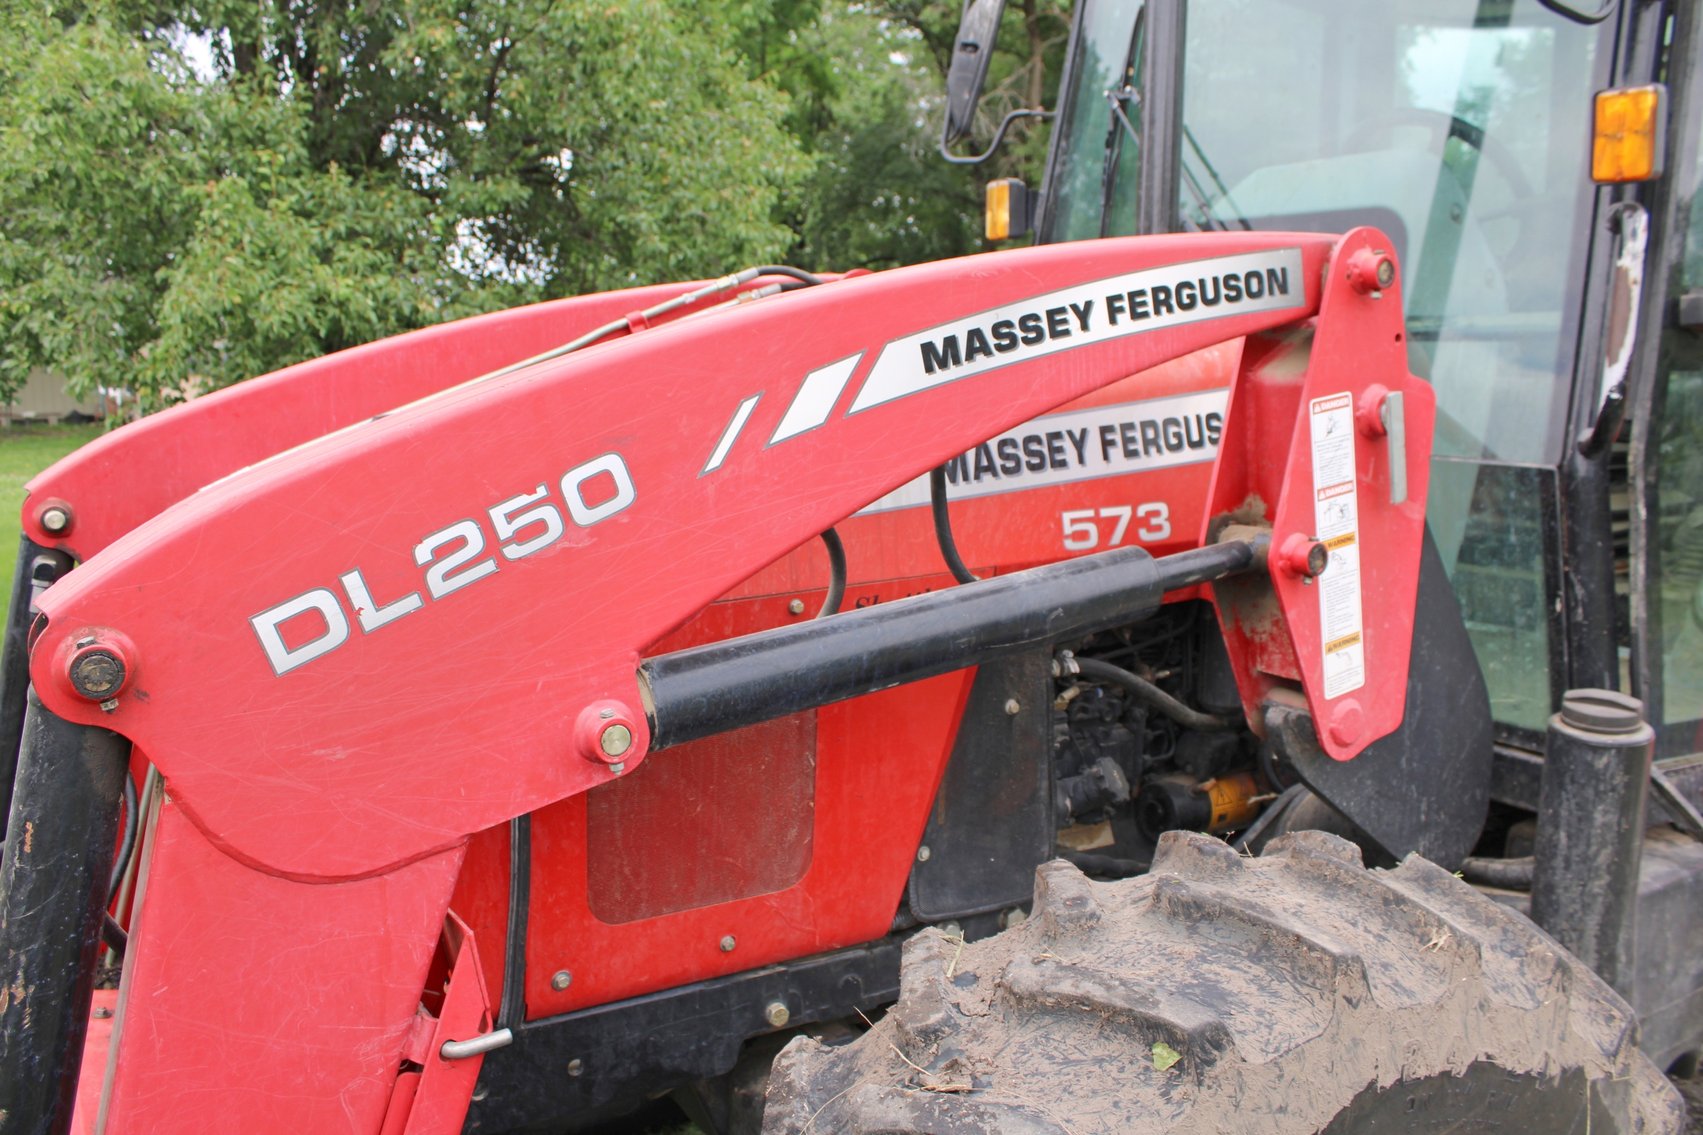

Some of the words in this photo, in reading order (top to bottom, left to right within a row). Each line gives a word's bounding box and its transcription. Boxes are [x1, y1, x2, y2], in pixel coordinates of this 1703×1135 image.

[920, 299, 1095, 375] MASSEY
[1105, 266, 1289, 326] FERGUSON
[1321, 397, 1349, 410] DANGER
[943, 426, 1088, 485] MASSEY
[1325, 483, 1353, 497] DANGER
[1061, 501, 1172, 551] 573
[1328, 534, 1356, 548] WARNING
[248, 451, 637, 677] DL250
[1332, 633, 1360, 649] WARNING
